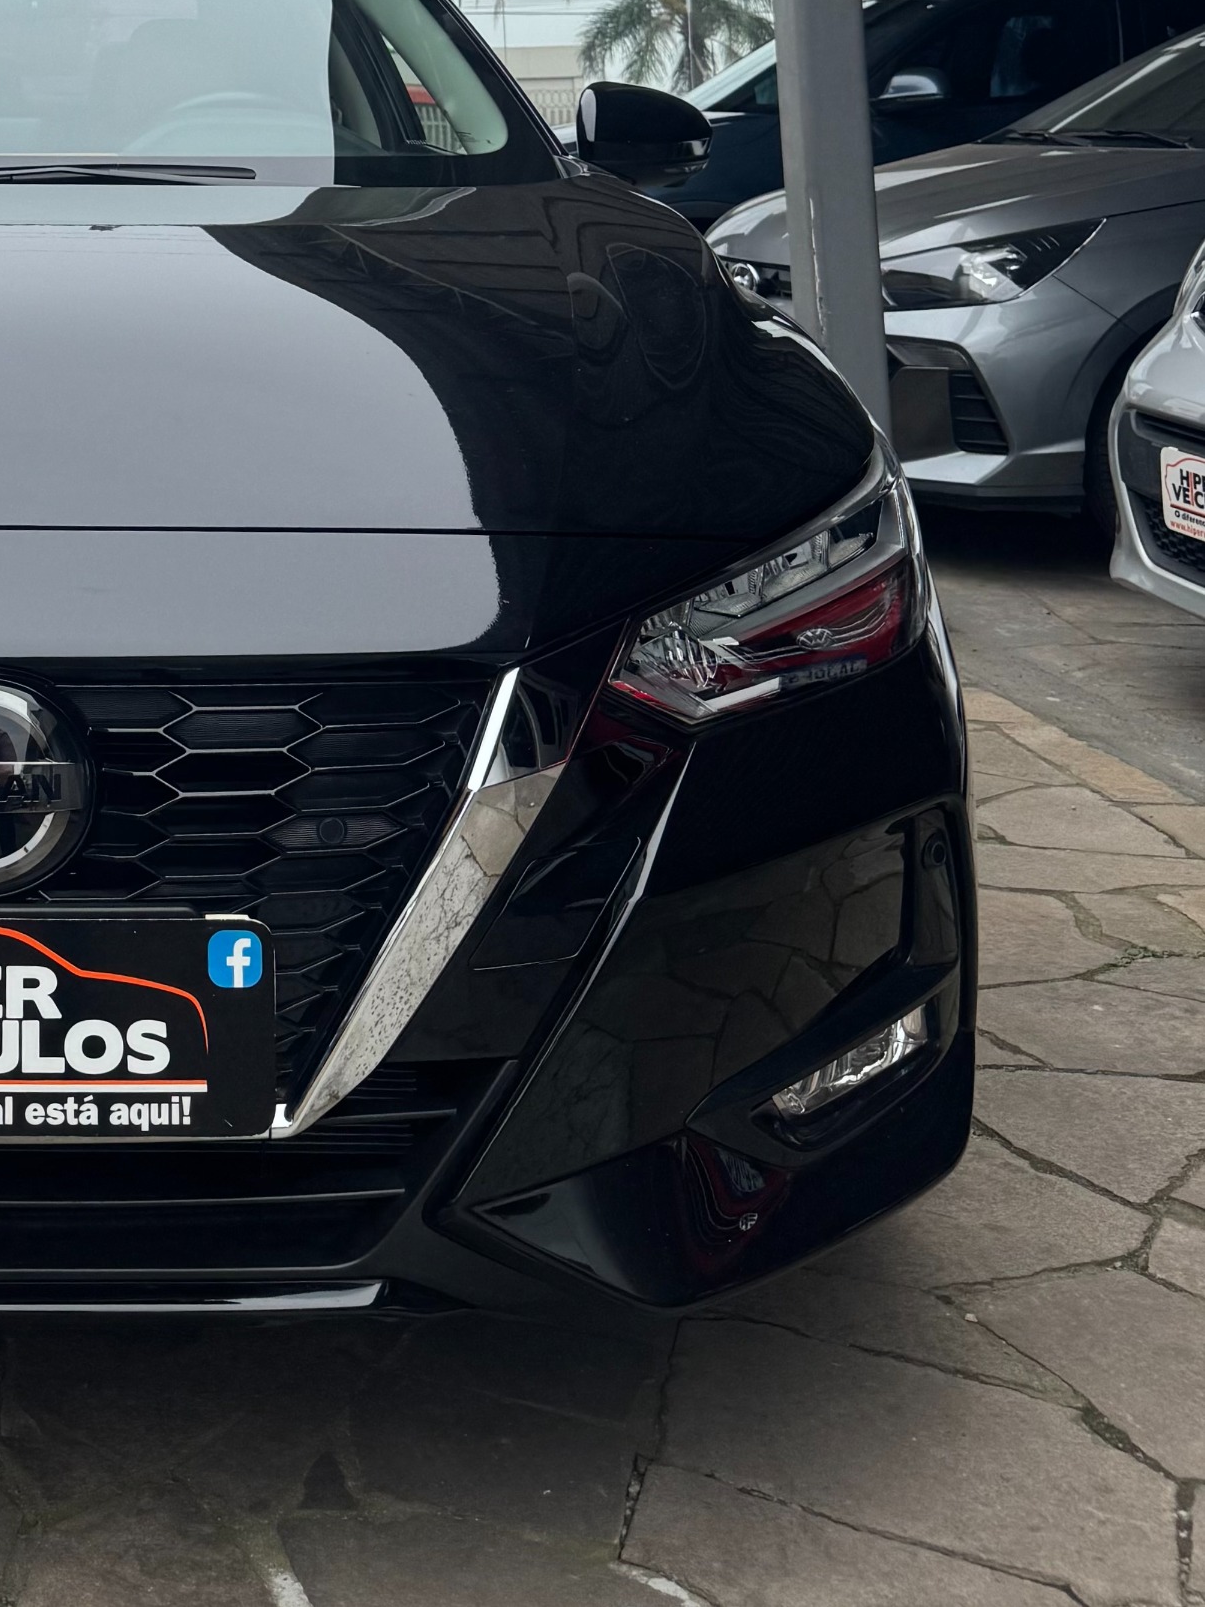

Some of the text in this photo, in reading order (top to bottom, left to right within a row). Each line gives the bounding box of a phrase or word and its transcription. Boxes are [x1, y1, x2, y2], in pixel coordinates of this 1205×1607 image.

[1172, 483, 1205, 510] VEIC
[24, 1095, 99, 1126] está
[109, 1096, 191, 1131] aqui!
